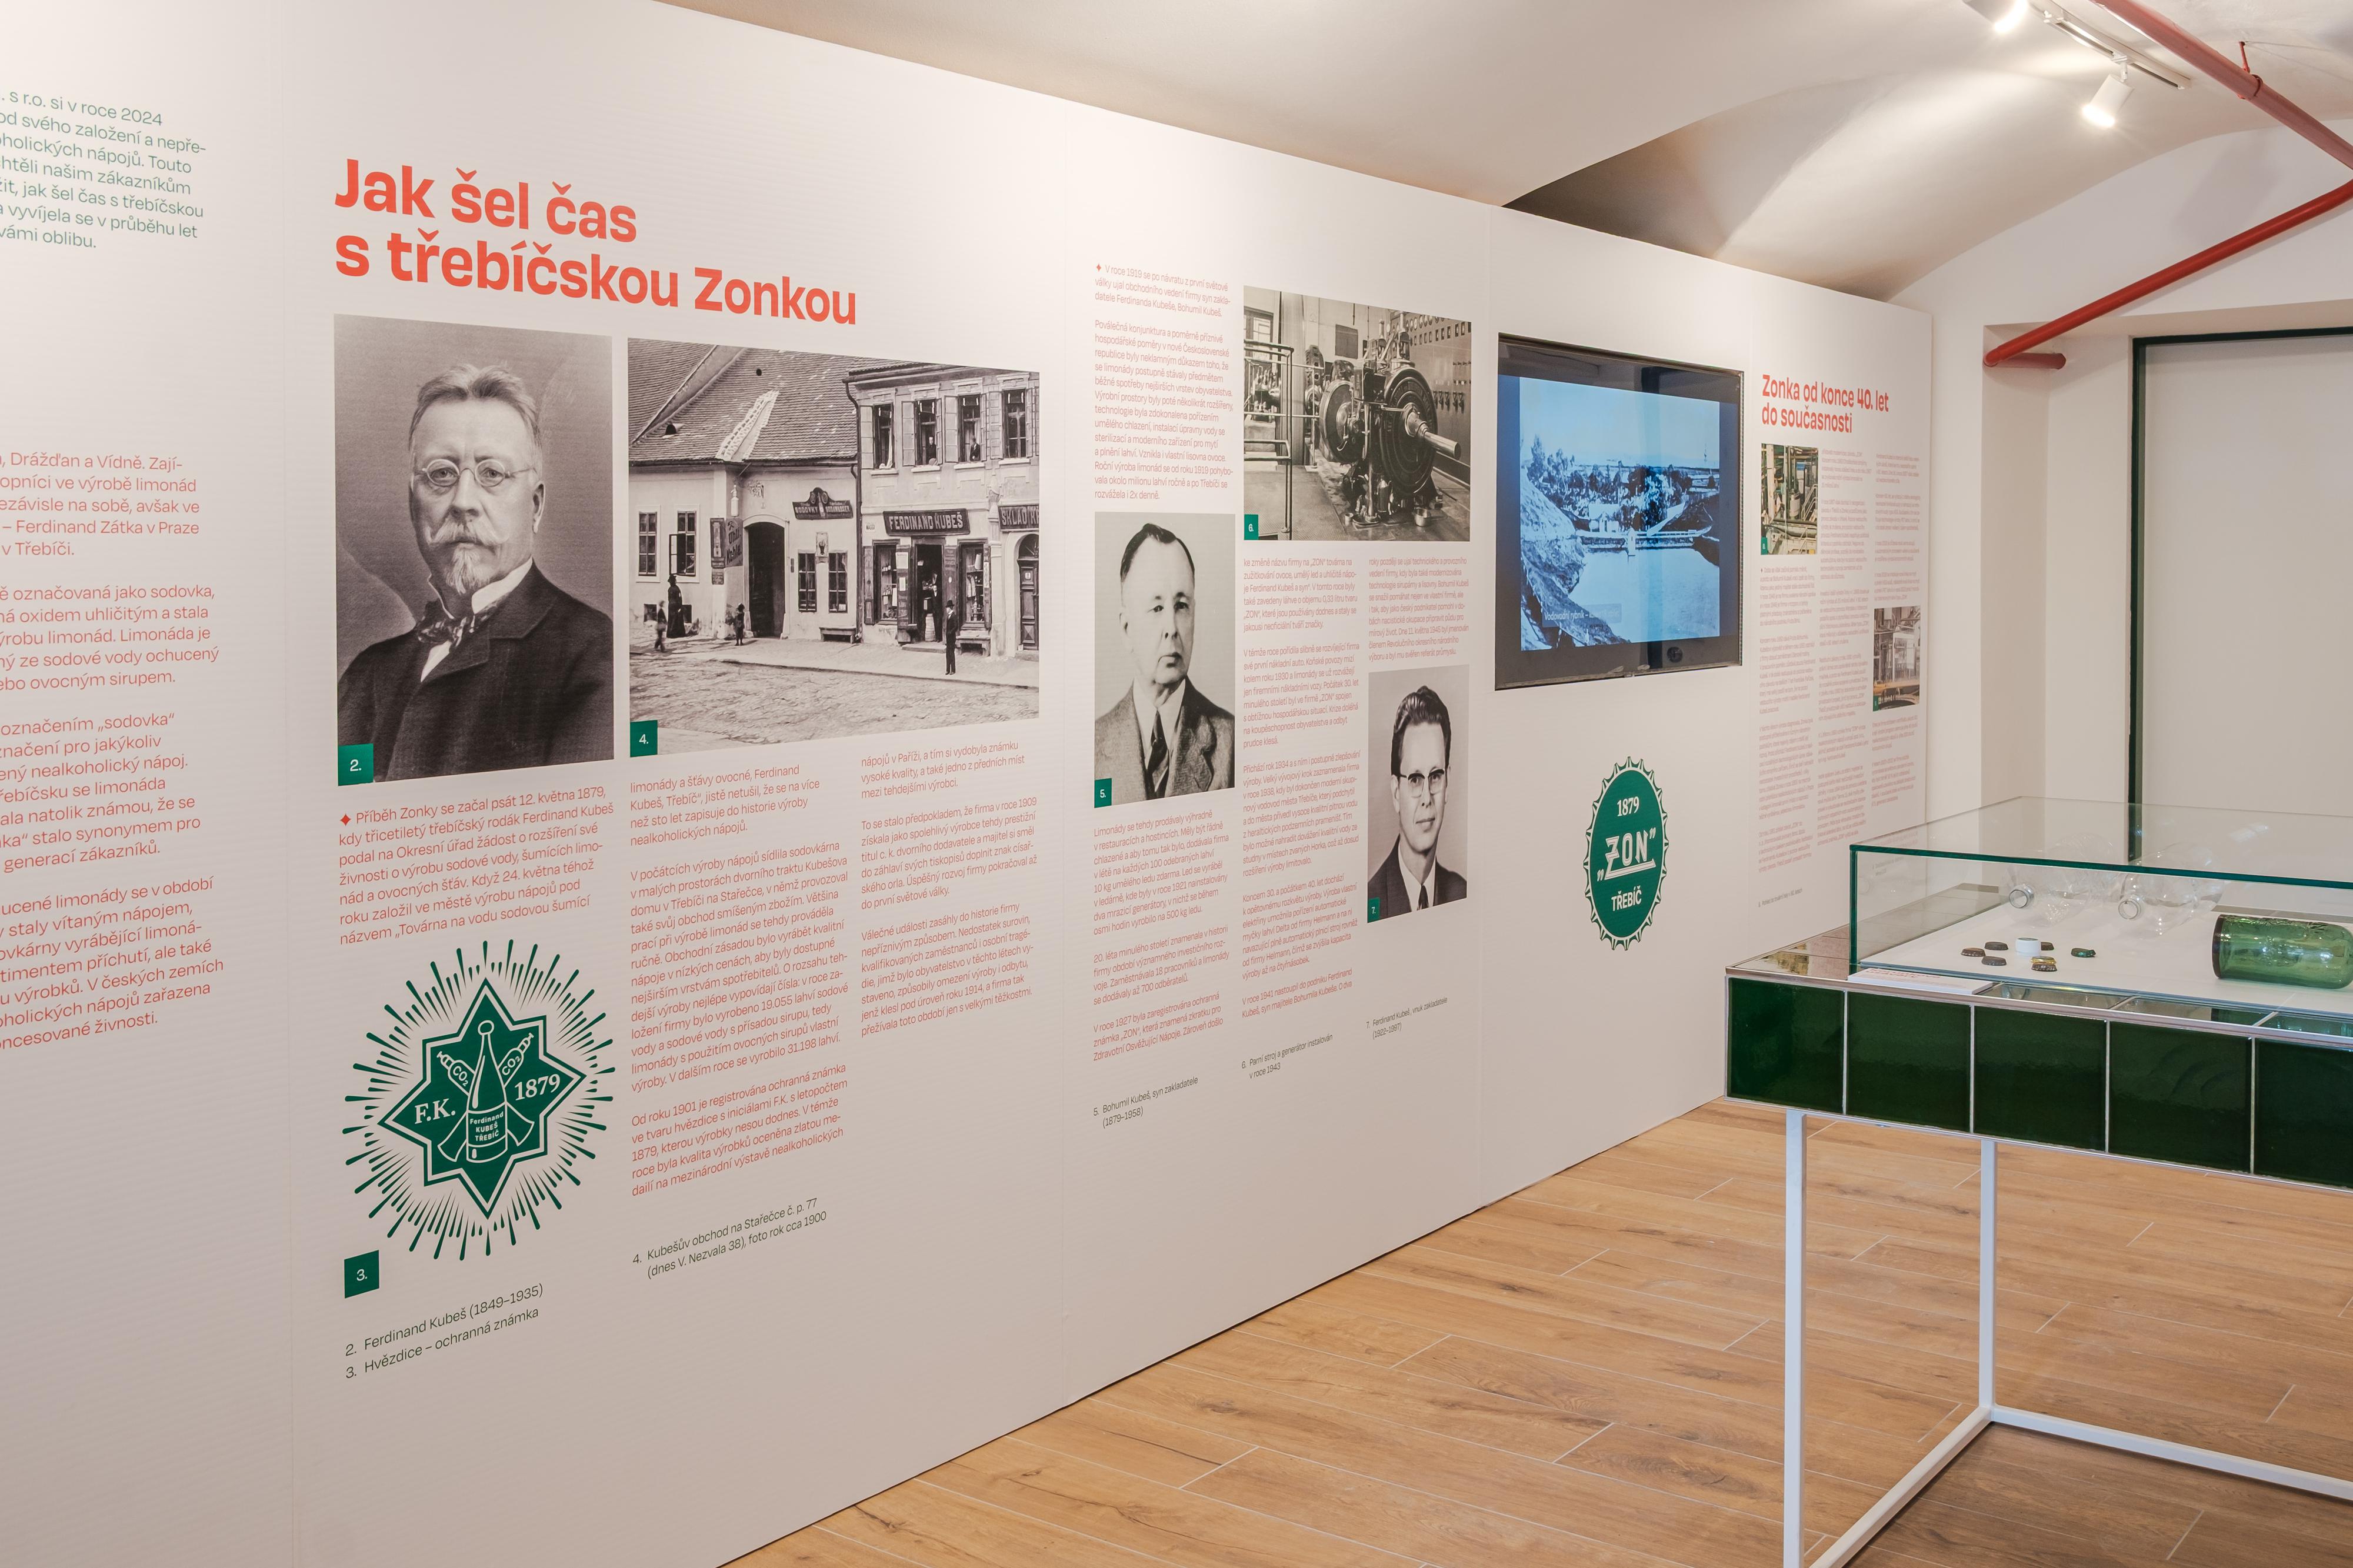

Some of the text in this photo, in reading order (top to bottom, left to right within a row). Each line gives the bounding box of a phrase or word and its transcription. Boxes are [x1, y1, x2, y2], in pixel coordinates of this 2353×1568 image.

[10, 92, 162, 126] s r.o. si v roce 2024
[22, 116, 71, 133] svého
[75, 125, 141, 144] založení
[145, 136, 152, 146] a
[158, 138, 206, 153] nepře-
[44, 164, 190, 194] našim zákazníkům
[334, 159, 637, 242] Jak šel čas
[8, 206, 197, 238] vyvíjela se v průběhu let
[336, 228, 855, 325] s třebíčskou Zonkou
[1762, 374, 1888, 412] Zonka od konce 40. let
[1762, 402, 1852, 433] do současnosti
[11, 452, 182, 473] Drážďan a Vídně. Zají-
[16, 520, 95, 533] Ferdinand
[101, 520, 142, 533] Zátka
[147, 525, 155, 533] v
[159, 522, 199, 534] Praze
[888, 512, 964, 530] FERDINAND KUBEŠ
[1248, 523, 1254, 532] 6.
[2, 541, 74, 555] v Třebíči.
[639, 734, 649, 745] 4.
[350, 759, 361, 771] 2.
[862, 753, 889, 768] nápojů
[898, 751, 921, 762] Paříži,
[930, 749, 944, 759] tím
[946, 748, 951, 757] si
[954, 744, 987, 758] vydobyla
[989, 741, 1018, 752] známku
[631, 765, 799, 793] limonády a šťávy ovocné, Ferdinand
[356, 786, 605, 823] Příběh Zonky se začal psát 12. května 1879,
[1100, 789, 1106, 798] 5.
[1617, 796, 1639, 817] 1879
[340, 802, 614, 846] kdy třicetiletý třebíčský rodák Ferdinand Kubeš
[1094, 824, 1126, 836] Limonády
[1136, 820, 1154, 830] tehdy
[1155, 815, 1184, 828] prodávaly
[1185, 810, 1212, 823] výhradně
[1371, 906, 1376, 915] 7.
[1611, 885, 1642, 912] TŘEBÍČ
[1249, 1055, 1264, 1066] Parní
[1265, 1050, 1277, 1061] stroj
[1282, 1043, 1307, 1057] generátor
[1308, 1034, 1332, 1047] instalován
[1254, 1069, 1266, 1077] roce
[1267, 1062, 1280, 1073] 1943
[514, 1073, 561, 1101] 1879
[1094, 1076, 1198, 1116] 5. Bohumil Kubeš, syn zakladatele
[414, 1098, 456, 1125] F.K.
[469, 1111, 504, 1125] Ferdinand
[475, 1122, 498, 1133] KUBEŠ
[475, 1130, 499, 1142] TŘEBÍČ
[633, 1197, 817, 1263] 4. Kubešův obchod na Stařečce č. p. 77
[648, 1211, 826, 1279] (dnes V. Nezvala 38), foto rok cca 1900
[356, 1269, 368, 1281] 3.
[346, 1344, 356, 1356] 2.
[365, 1320, 426, 1350] Ferdinand
[431, 1307, 466, 1329] Kubeš
[346, 1367, 356, 1378] 3.
[365, 1347, 422, 1373] Hvězdice
[435, 1321, 490, 1349] ochranná
[494, 1309, 538, 1330] známka
